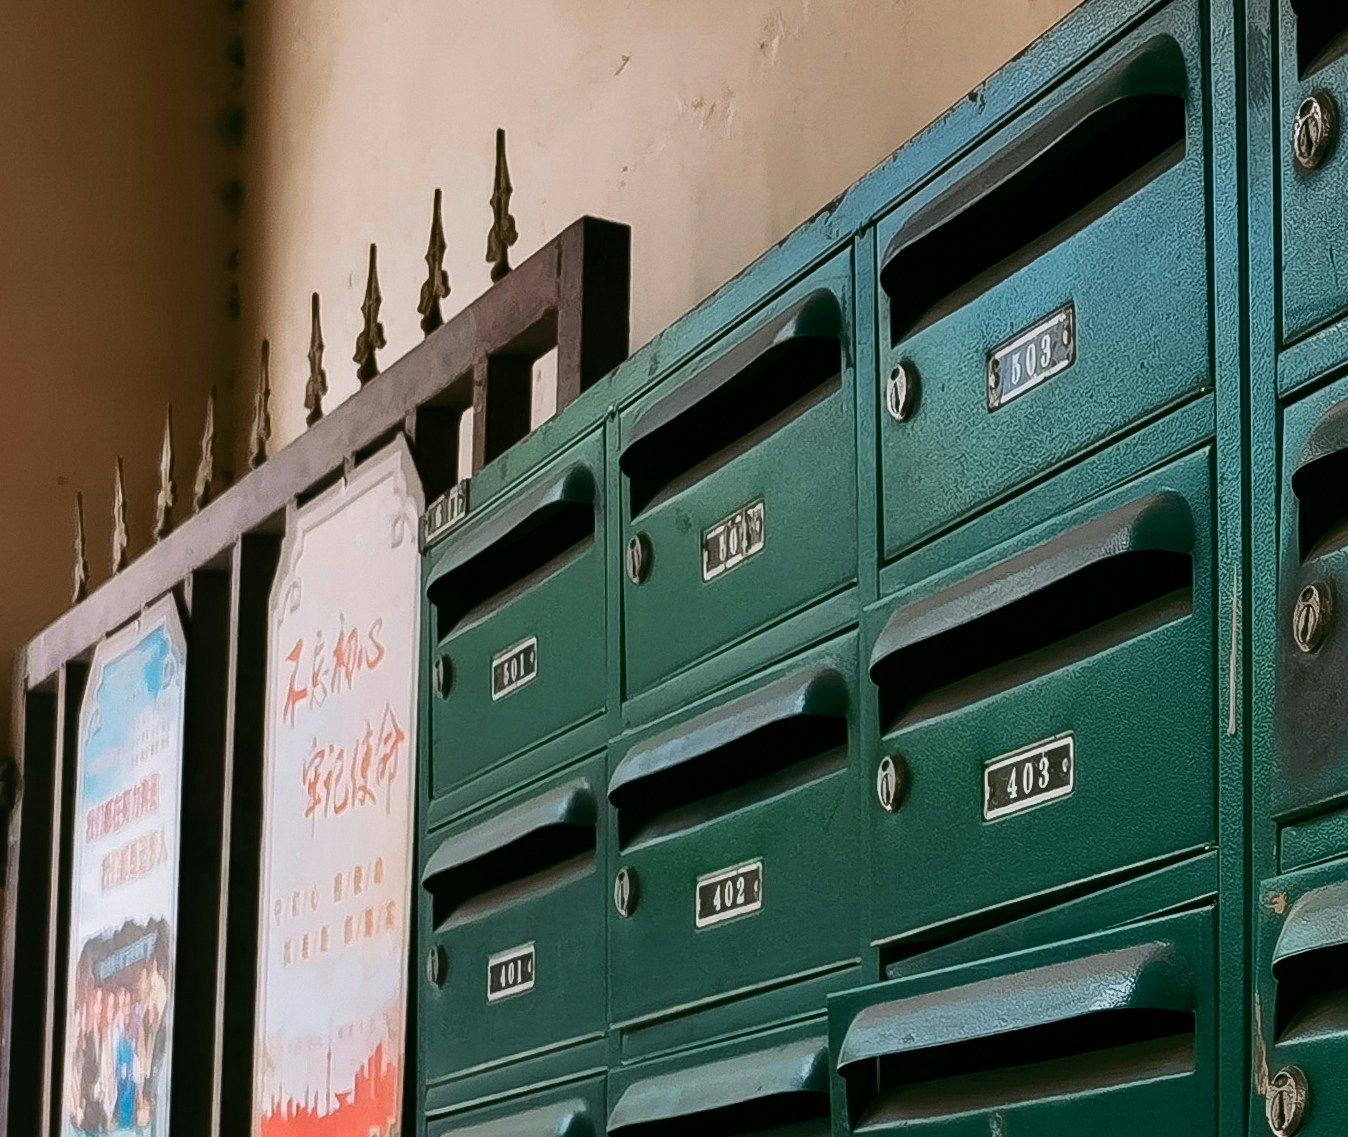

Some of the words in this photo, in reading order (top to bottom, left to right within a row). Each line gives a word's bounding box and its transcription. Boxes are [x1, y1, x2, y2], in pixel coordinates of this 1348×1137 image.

[1011, 334, 1052, 385] 503
[1006, 756, 1050, 799] 403
[713, 876, 745, 912] 402
[499, 959, 522, 988] 401
